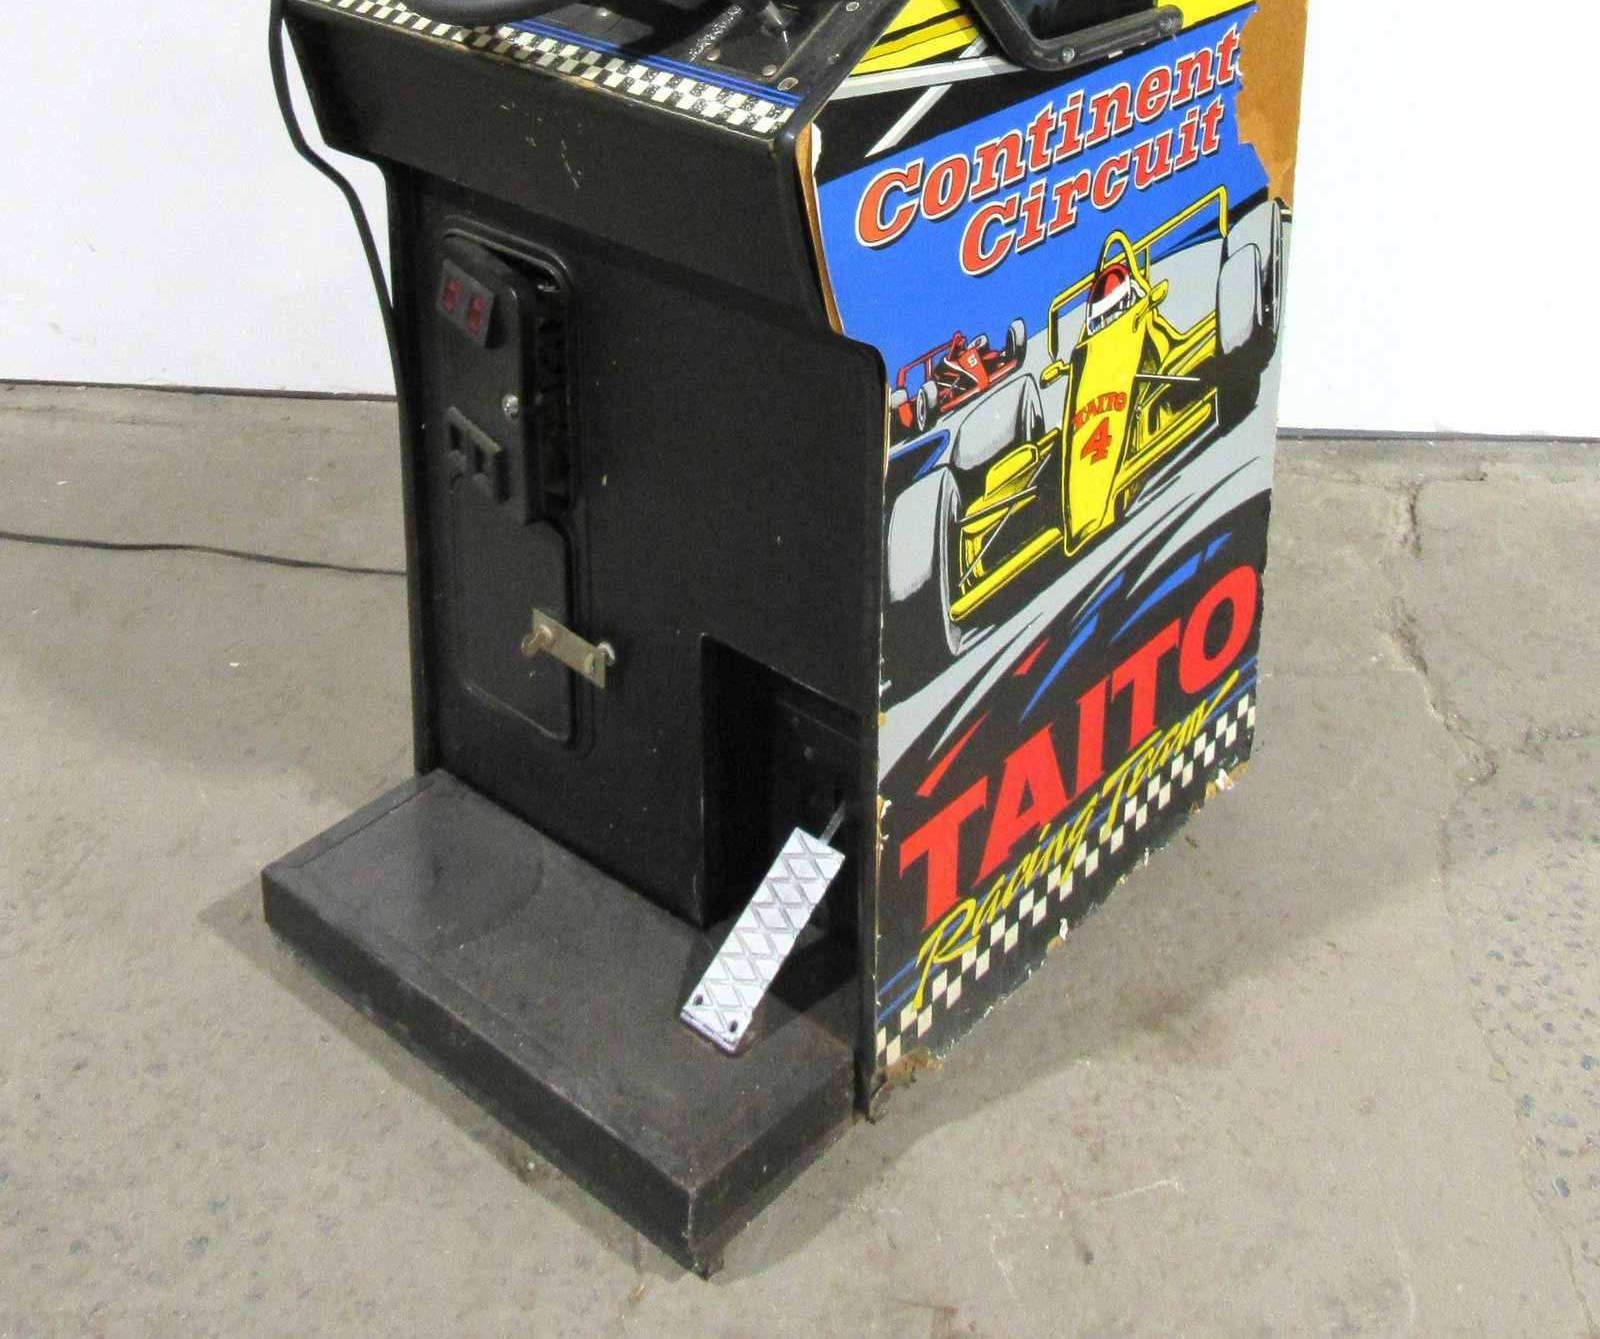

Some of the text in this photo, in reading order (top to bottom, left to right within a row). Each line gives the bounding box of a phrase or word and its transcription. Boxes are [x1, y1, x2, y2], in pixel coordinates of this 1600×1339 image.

[855, 21, 1240, 248] Continent
[958, 94, 1227, 276] Circuit
[1072, 391, 1128, 432] TAITO
[1080, 416, 1112, 464] 4
[900, 565, 1259, 932] TAITO
[914, 669, 1240, 1010] Racing Team
